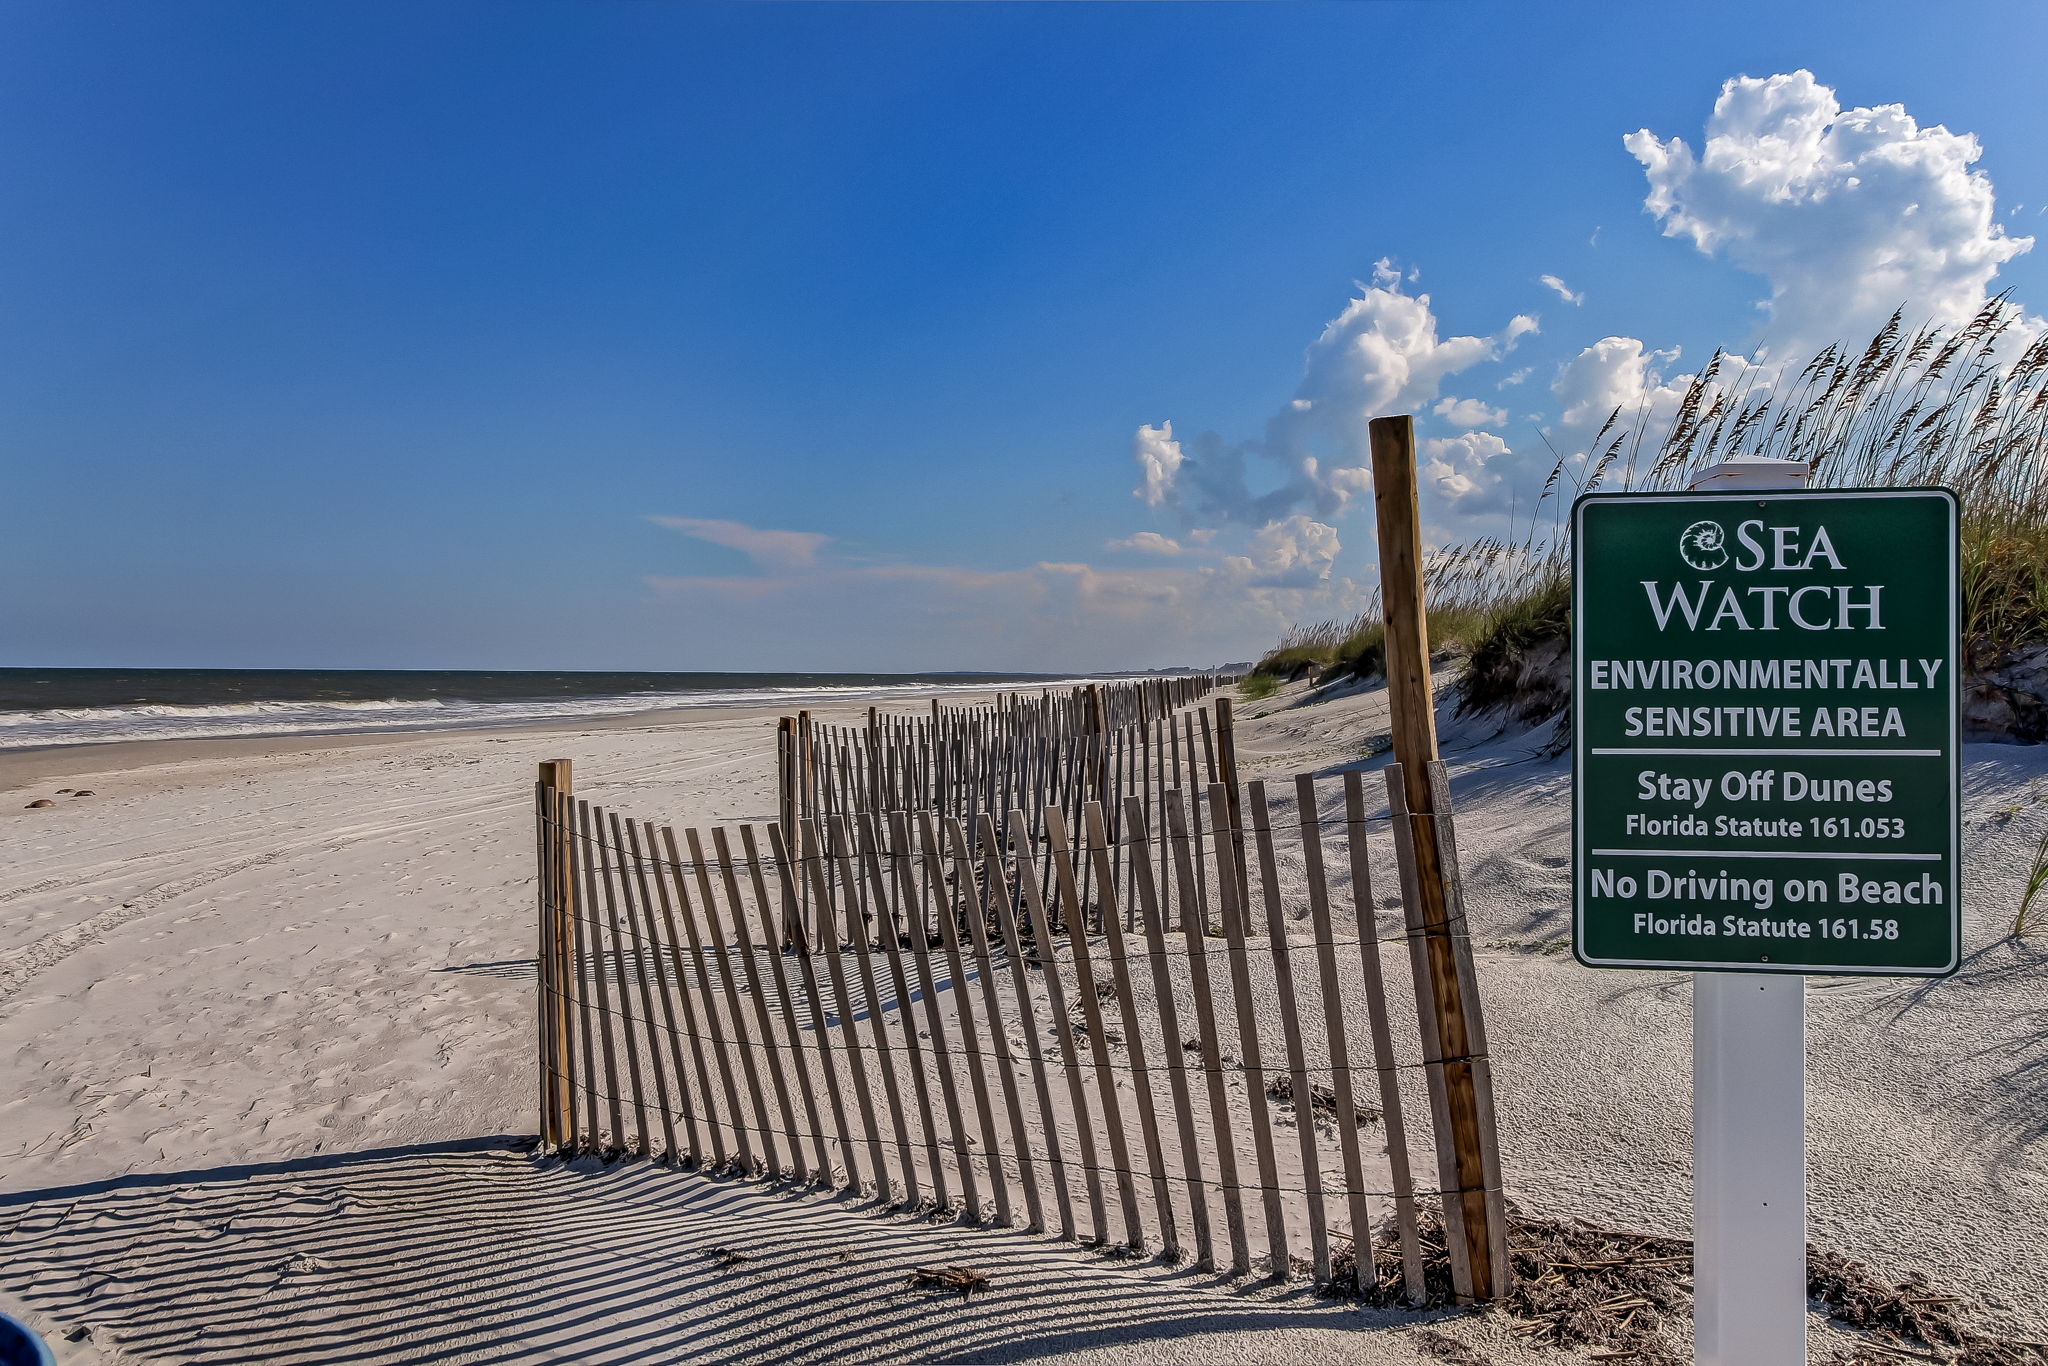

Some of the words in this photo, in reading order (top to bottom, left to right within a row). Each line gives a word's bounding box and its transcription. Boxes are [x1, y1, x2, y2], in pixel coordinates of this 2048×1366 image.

[1736, 520, 1847, 571] SEA
[1640, 581, 1886, 631] WATCH
[1592, 659, 1942, 689] ENVIRONMENTALLY
[1625, 707, 1801, 736] SENSITIVE
[1810, 708, 1906, 736] AREA
[1638, 771, 1712, 808] Stay
[1721, 770, 1774, 800] Off
[1784, 772, 1892, 802] Dunes
[1627, 814, 1708, 835] Florida
[1715, 816, 1802, 837] Statute
[1810, 818, 1904, 838] 161.053
[1592, 869, 1637, 898] No
[1648, 870, 1773, 909] Driving
[1784, 880, 1827, 902] on
[1839, 873, 1942, 904] Beach
[1635, 913, 1715, 935] Florida
[1723, 916, 1810, 938] Statute
[1819, 919, 1898, 939] 161.58
